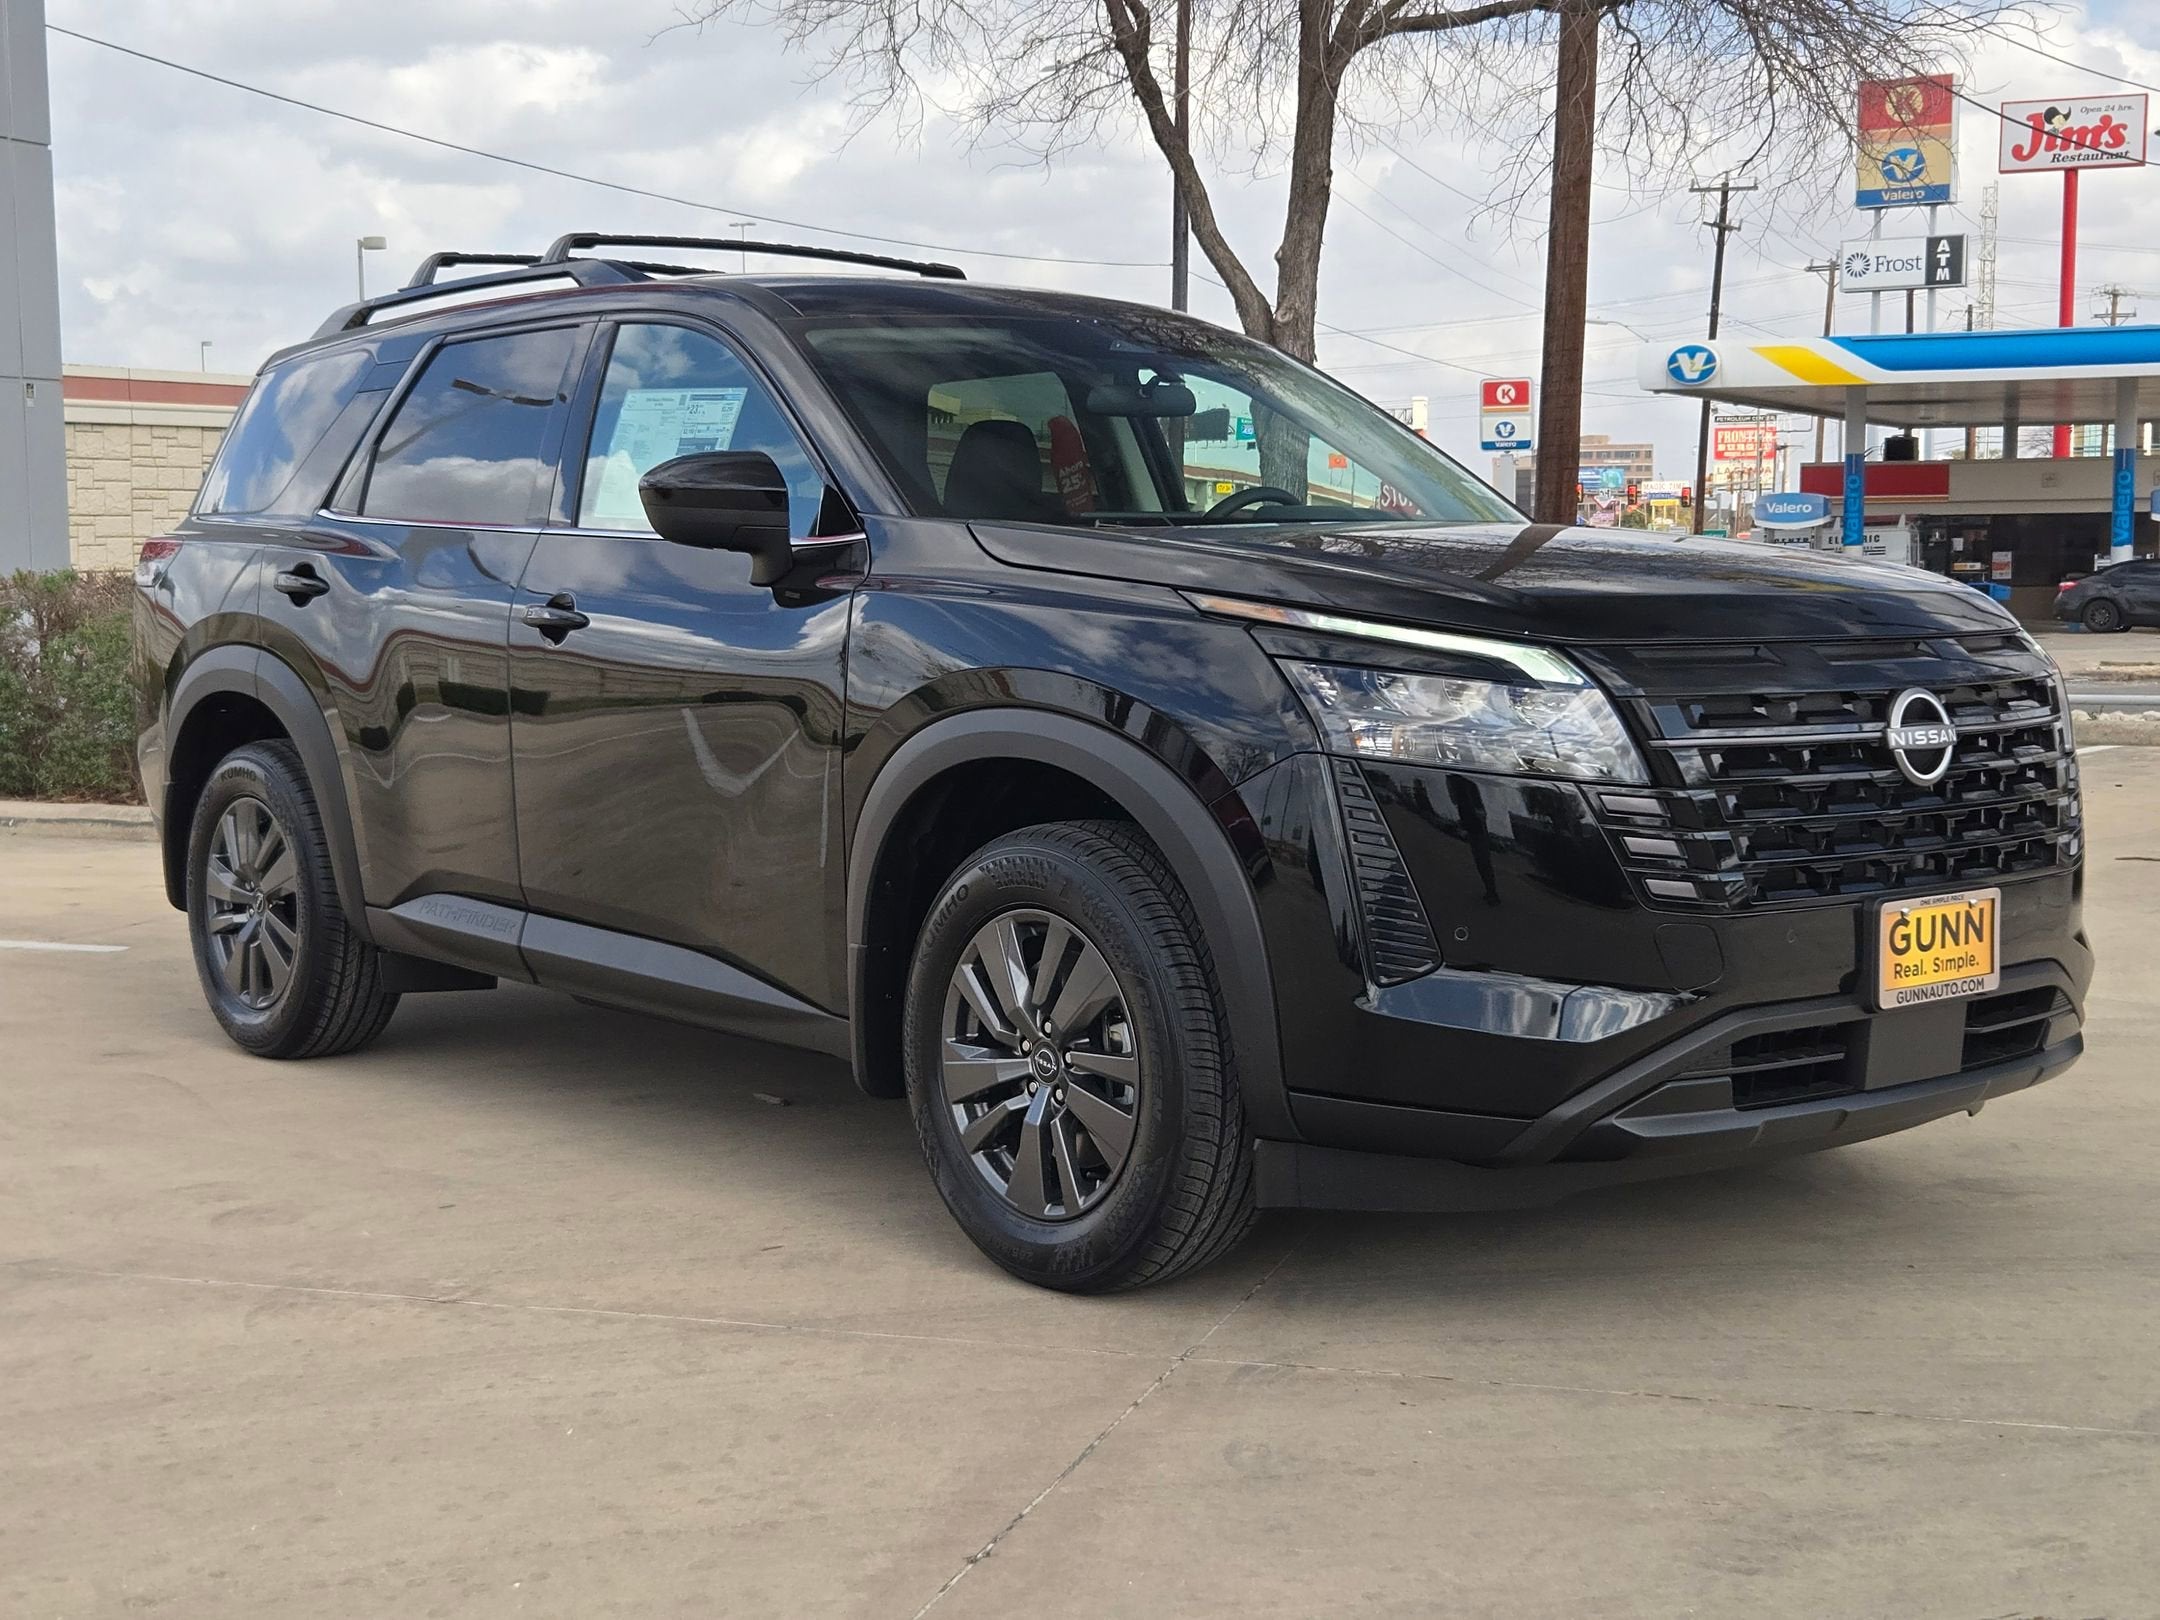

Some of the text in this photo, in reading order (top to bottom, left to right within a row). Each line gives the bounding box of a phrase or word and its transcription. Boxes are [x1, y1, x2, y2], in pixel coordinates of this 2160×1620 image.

[2080, 104, 2135, 115] Open 24 hrs.
[2011, 112, 2128, 162] Jim's
[2050, 150, 2130, 164] Restaurant
[1882, 189, 1925, 201] Valero
[1874, 255, 1922, 273] Frost
[1936, 239, 1951, 281] ATM
[1501, 388, 1514, 402] K
[1766, 502, 1812, 514] Valero
[1844, 475, 1860, 544] Valero
[2112, 470, 2131, 543] Valero
[1890, 728, 1957, 746] NISSAN
[221, 766, 257, 782] KUMHO
[1889, 907, 1984, 956] GUNN
[1894, 959, 1927, 980] Real.
[1896, 978, 1985, 1004] GUNNAUTO.COM
